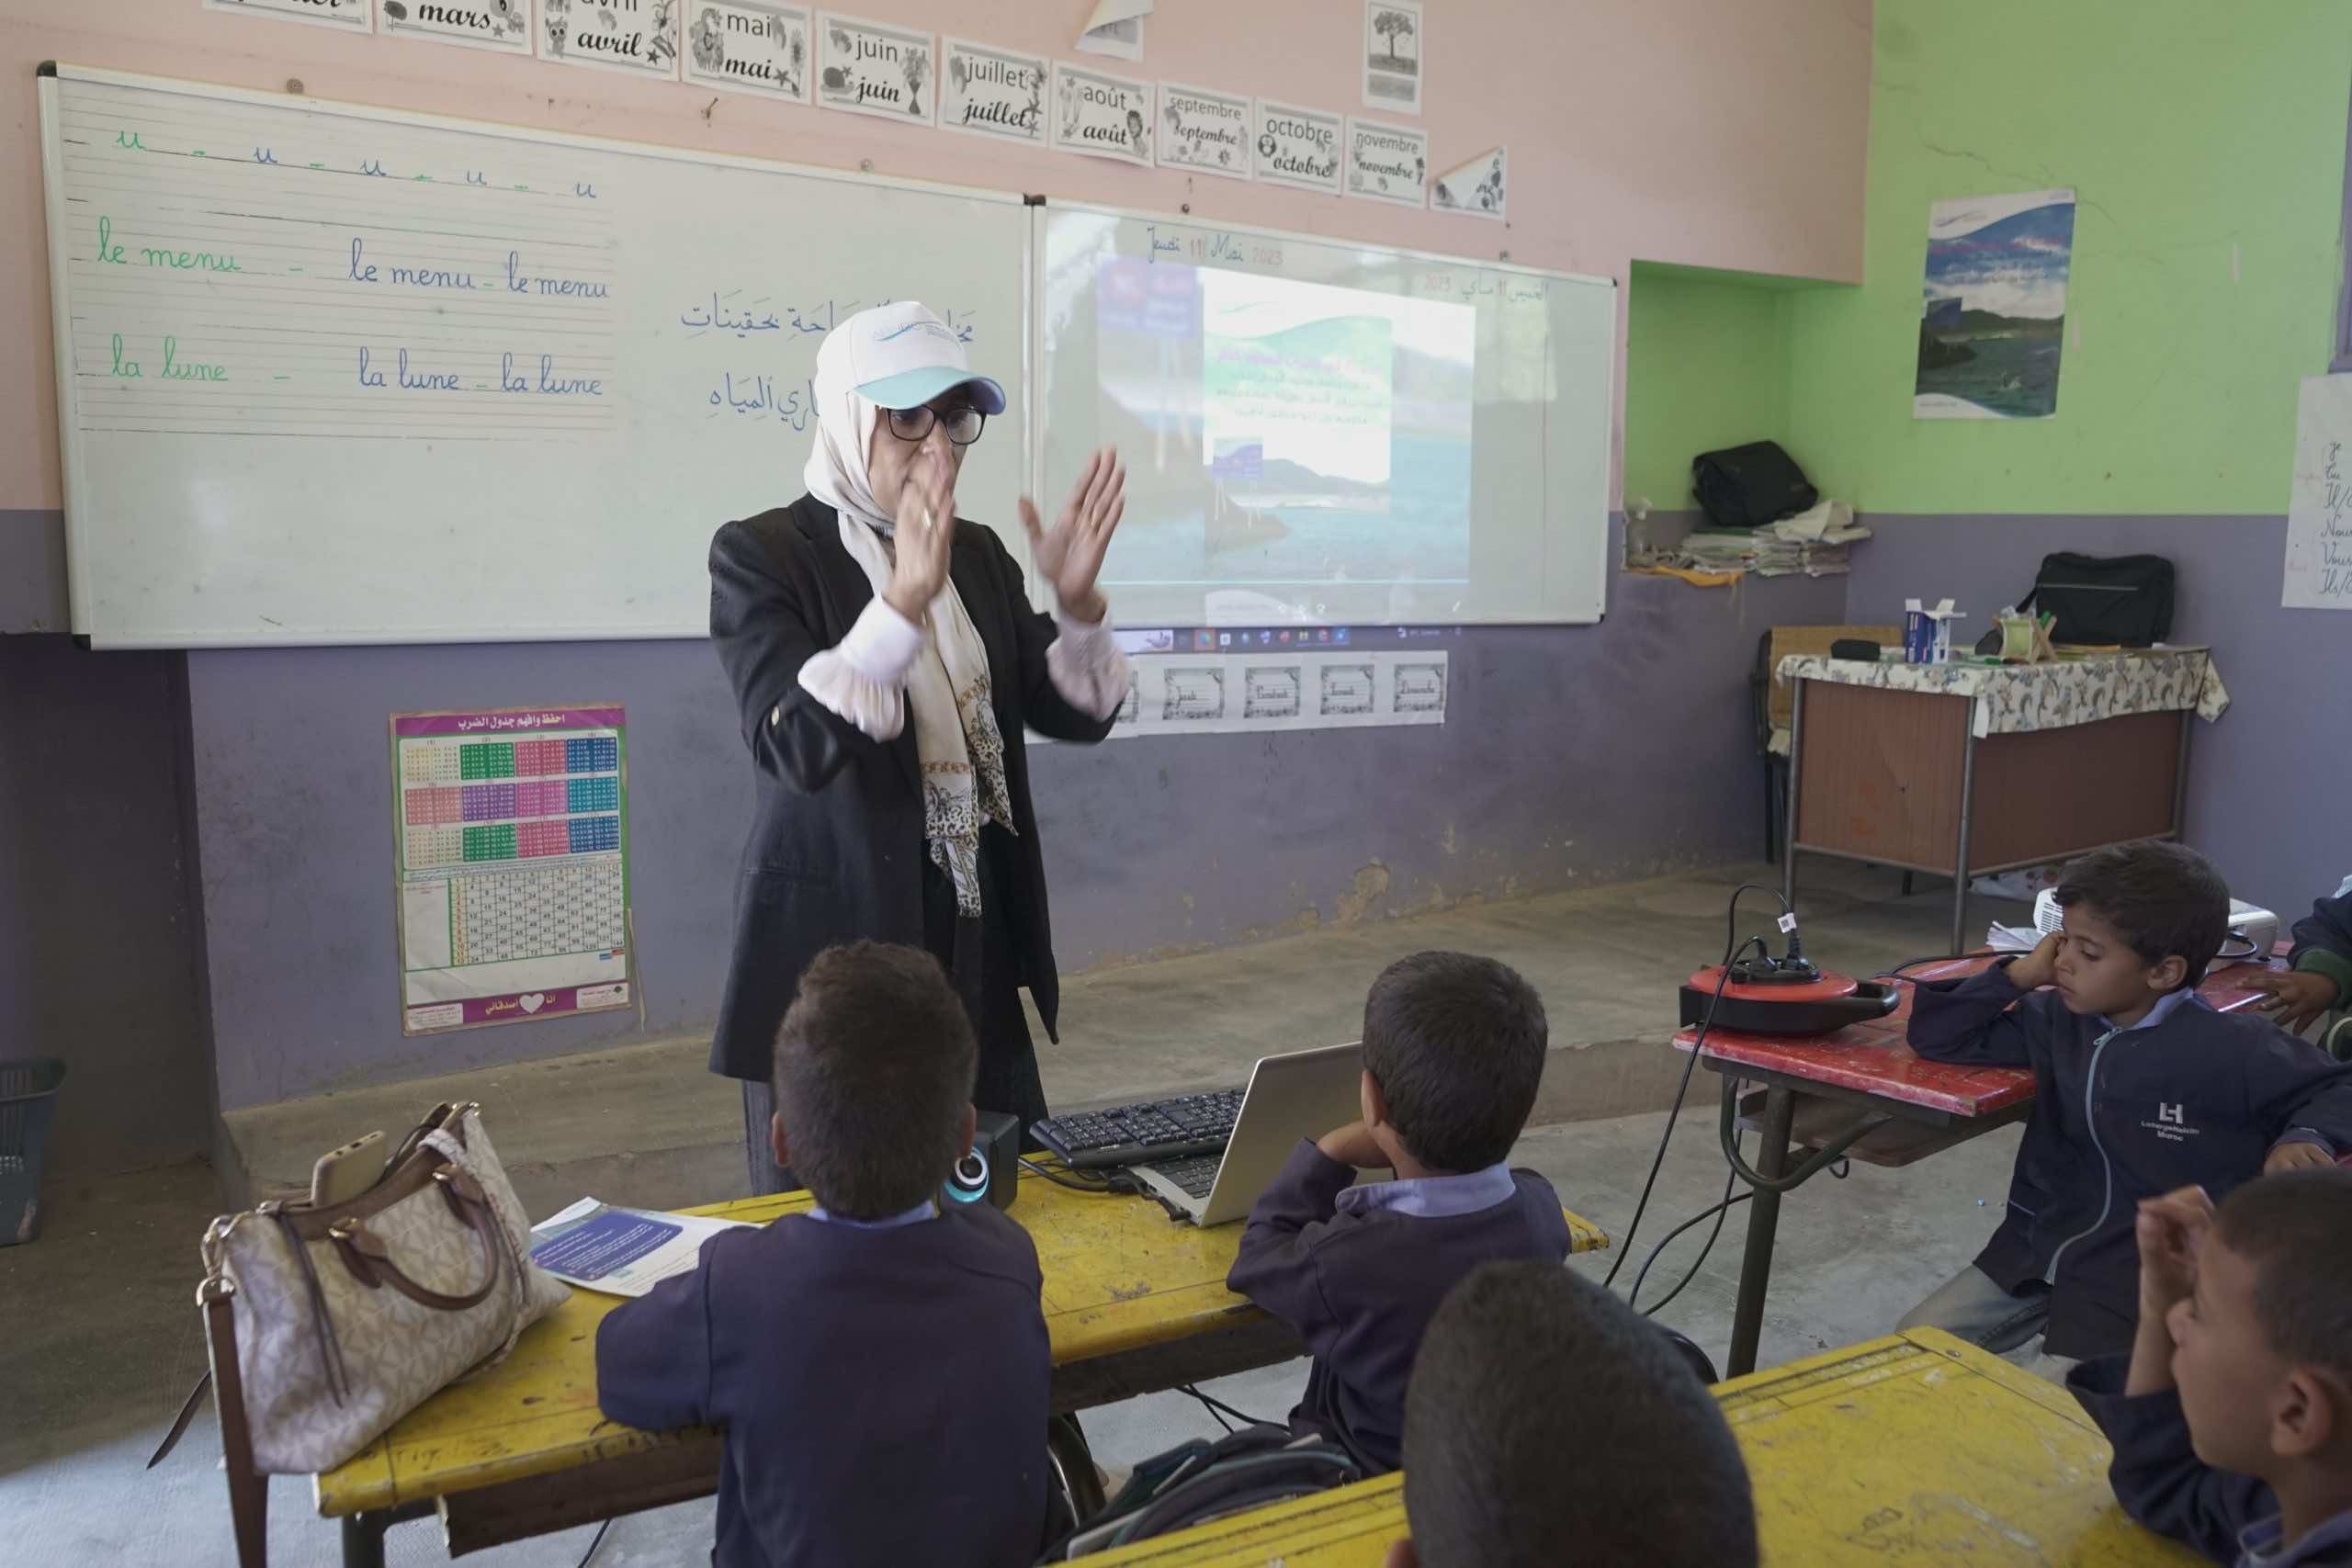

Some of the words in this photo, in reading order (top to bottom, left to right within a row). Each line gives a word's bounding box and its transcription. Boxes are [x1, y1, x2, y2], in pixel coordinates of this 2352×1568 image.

[419, 3, 491, 29] mars
[727, 14, 772, 37] mai
[577, 32, 642, 57] avril
[855, 34, 899, 62] juin
[724, 59, 773, 79] mai
[966, 56, 1028, 90] juillet
[854, 76, 899, 103] juin
[1083, 85, 1127, 110] août
[962, 98, 1029, 128] juillet
[1170, 96, 1242, 121] septembre
[1083, 124, 1128, 145] août
[1267, 117, 1333, 145] octobre
[1355, 131, 1419, 155] novembre
[116, 130, 148, 151] u
[254, 147, 277, 164] u
[360, 160, 387, 177] u
[466, 171, 487, 186] u
[573, 183, 597, 199] u
[1272, 152, 1332, 178] octobre
[1357, 159, 1414, 181] novembre
[97, 216, 127, 265] le
[141, 248, 242, 270] menu
[348, 237, 378, 282] le
[390, 265, 477, 289] menu
[506, 250, 528, 294] le
[534, 276, 608, 299] menu
[1147, 227, 1181, 265] Jeudi
[1211, 234, 1245, 263] Mai
[112, 333, 142, 378] la
[162, 335, 229, 382] lune
[359, 345, 387, 388] la
[397, 347, 460, 390] lune
[500, 352, 528, 392] la
[537, 354, 604, 396] lune
